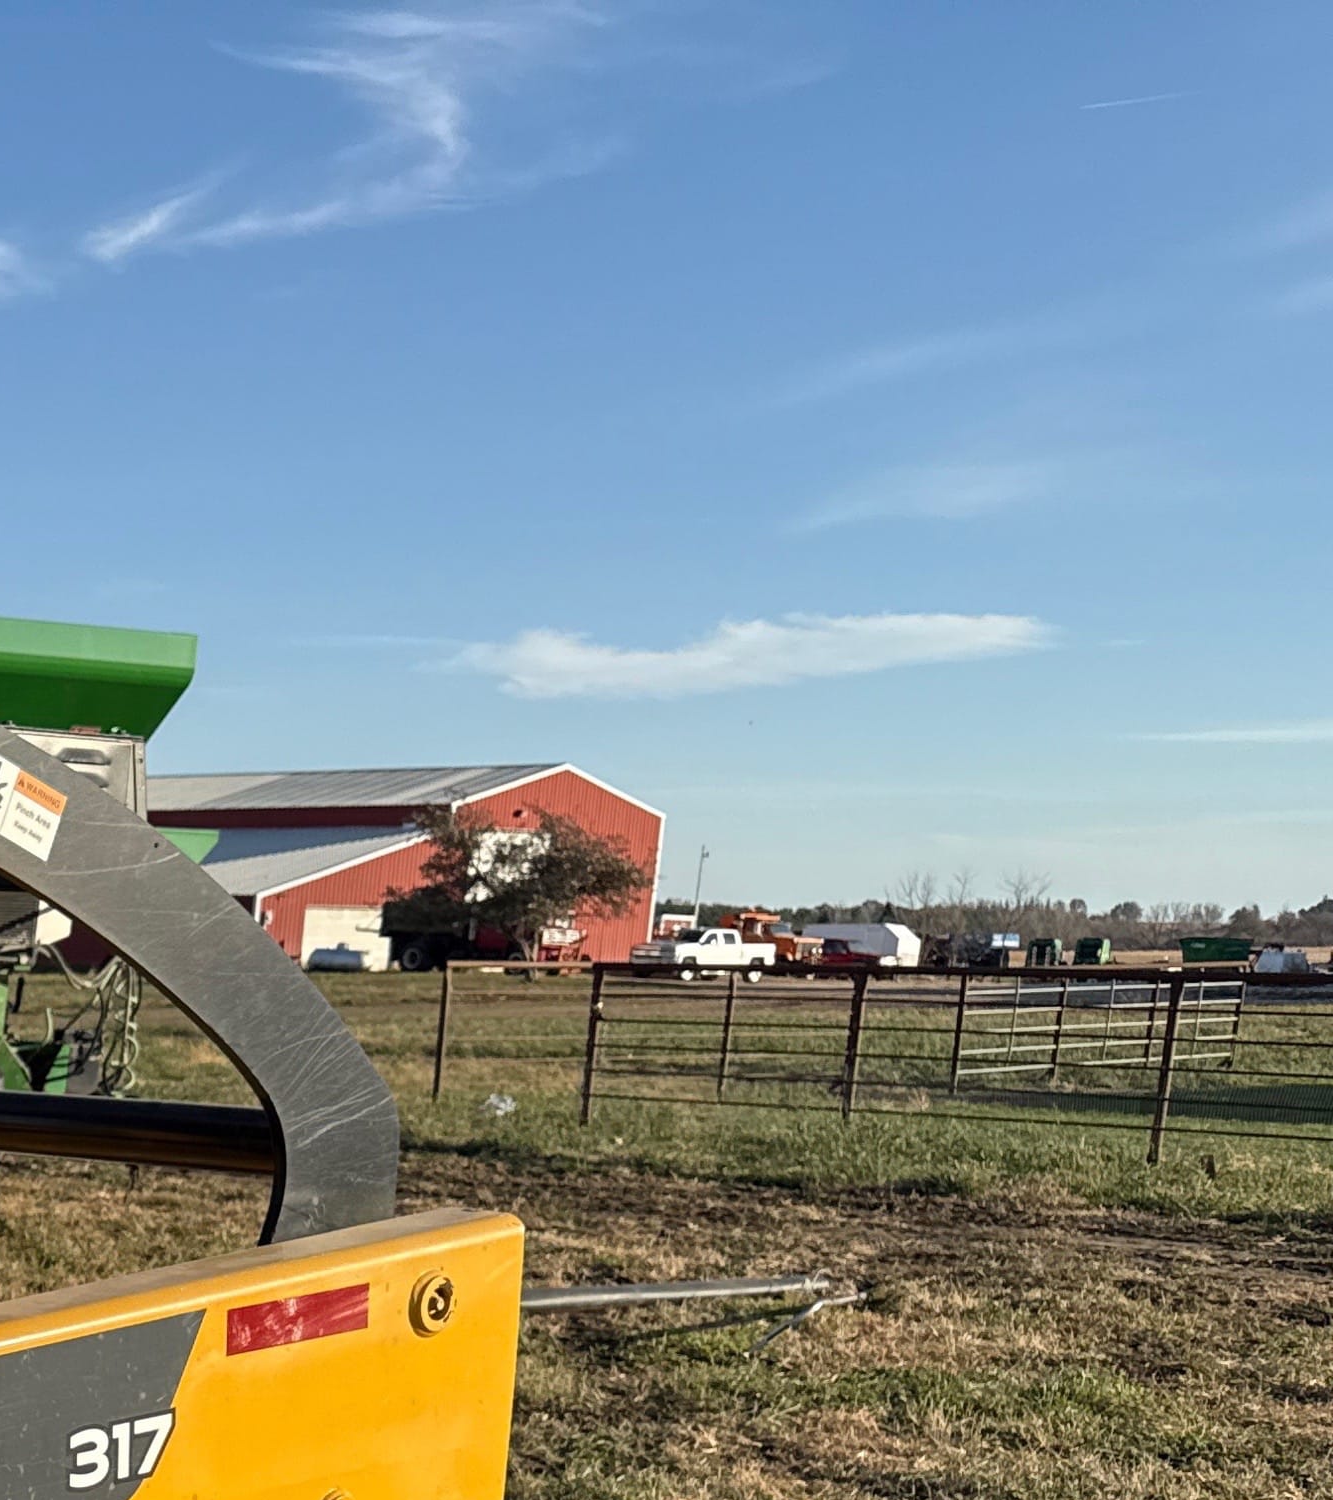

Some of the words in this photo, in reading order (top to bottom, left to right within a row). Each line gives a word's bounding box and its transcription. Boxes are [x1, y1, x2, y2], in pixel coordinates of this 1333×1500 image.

[26, 781, 61, 809] WARNING
[15, 801, 35, 820] Pinch
[35, 815, 52, 830] Area
[69, 1411, 173, 1488] 317
